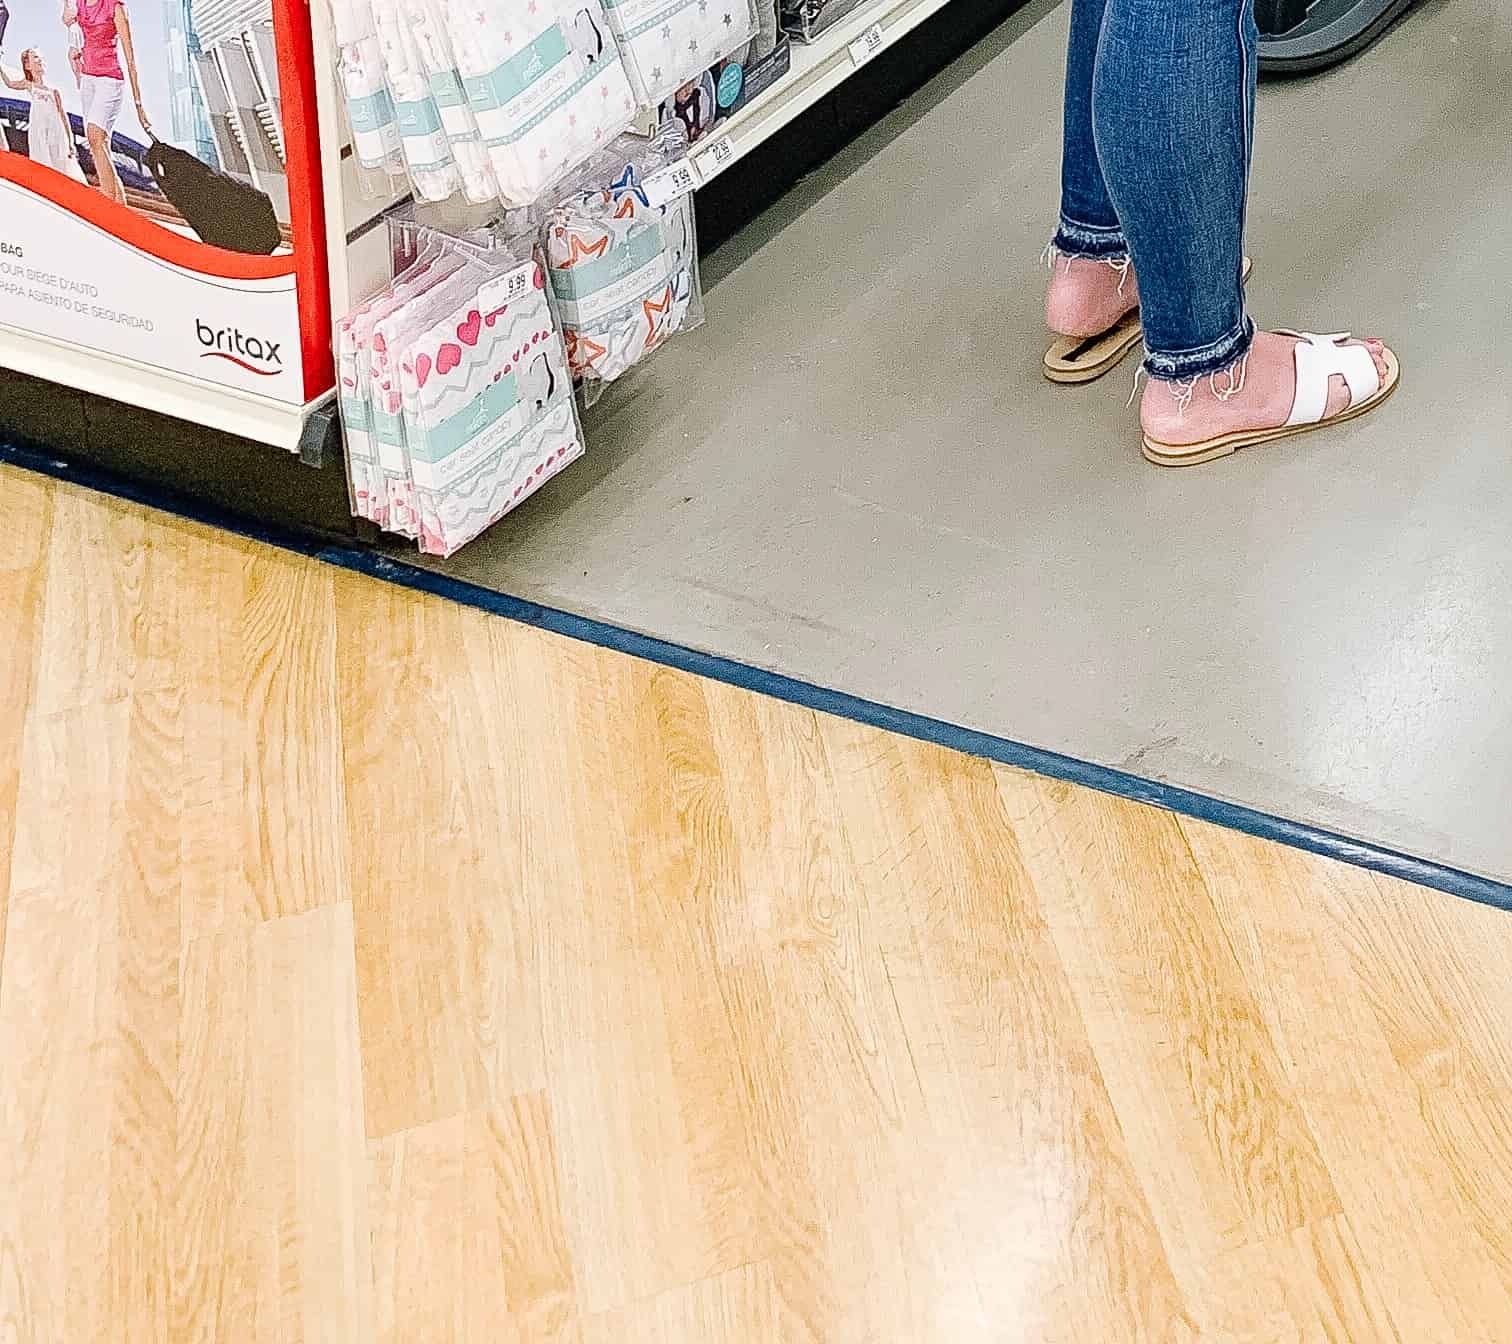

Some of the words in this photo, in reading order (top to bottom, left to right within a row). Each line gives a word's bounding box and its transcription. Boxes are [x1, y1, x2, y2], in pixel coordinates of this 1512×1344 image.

[0, 242, 24, 258] BAG
[28, 289, 72, 311] ASIENTO
[74, 300, 89, 315] DE
[91, 304, 154, 332] SEGURIDAD
[196, 318, 282, 365] britax
